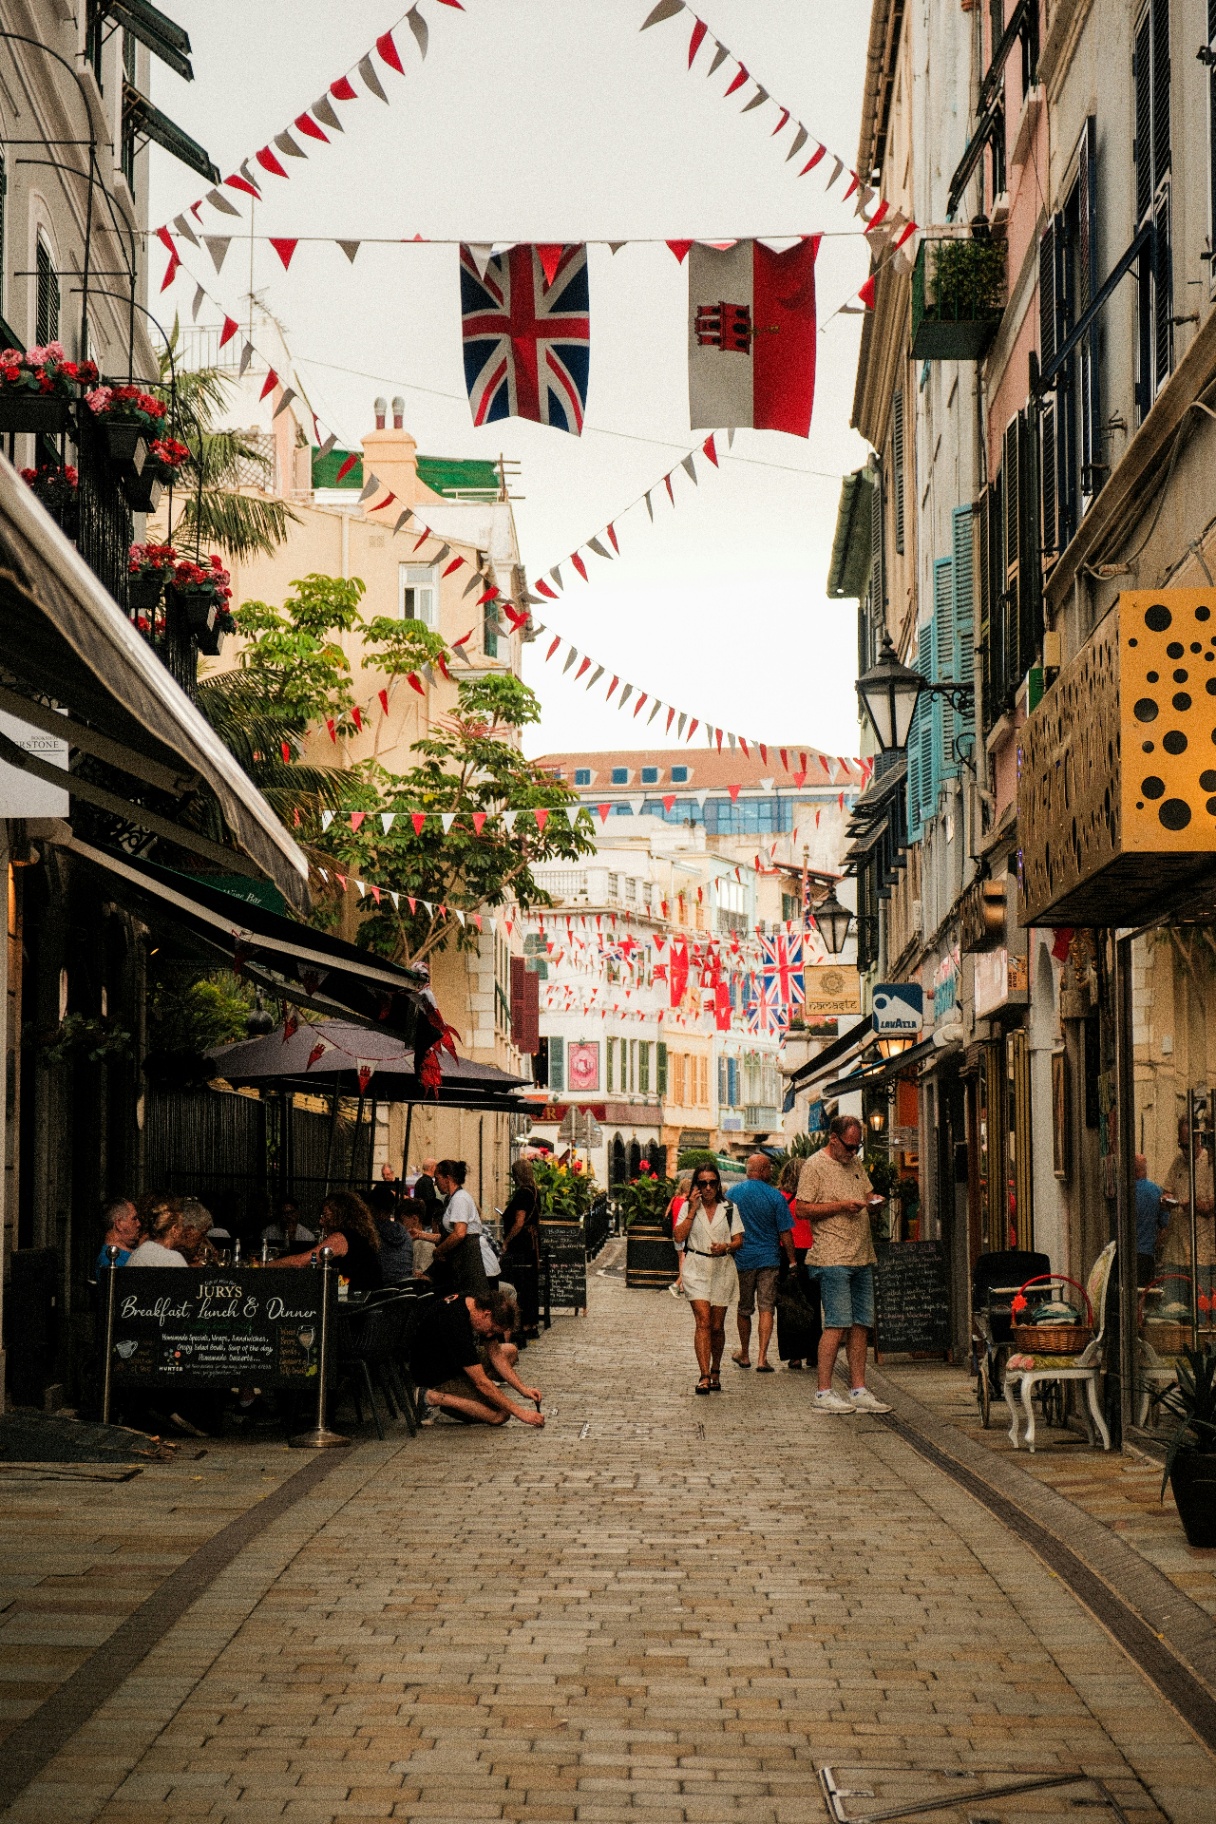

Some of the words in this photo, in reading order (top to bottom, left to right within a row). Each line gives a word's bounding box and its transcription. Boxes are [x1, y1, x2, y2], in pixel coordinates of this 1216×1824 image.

[808, 1000, 858, 1011] namaste
[880, 1018, 918, 1029] LAVAZZA
[196, 1285, 244, 1300] JURYS
[120, 1295, 194, 1327] Breakfast,
[198, 1297, 241, 1320] Lunch
[243, 1295, 260, 1318] &
[266, 1296, 317, 1320] Dinner
